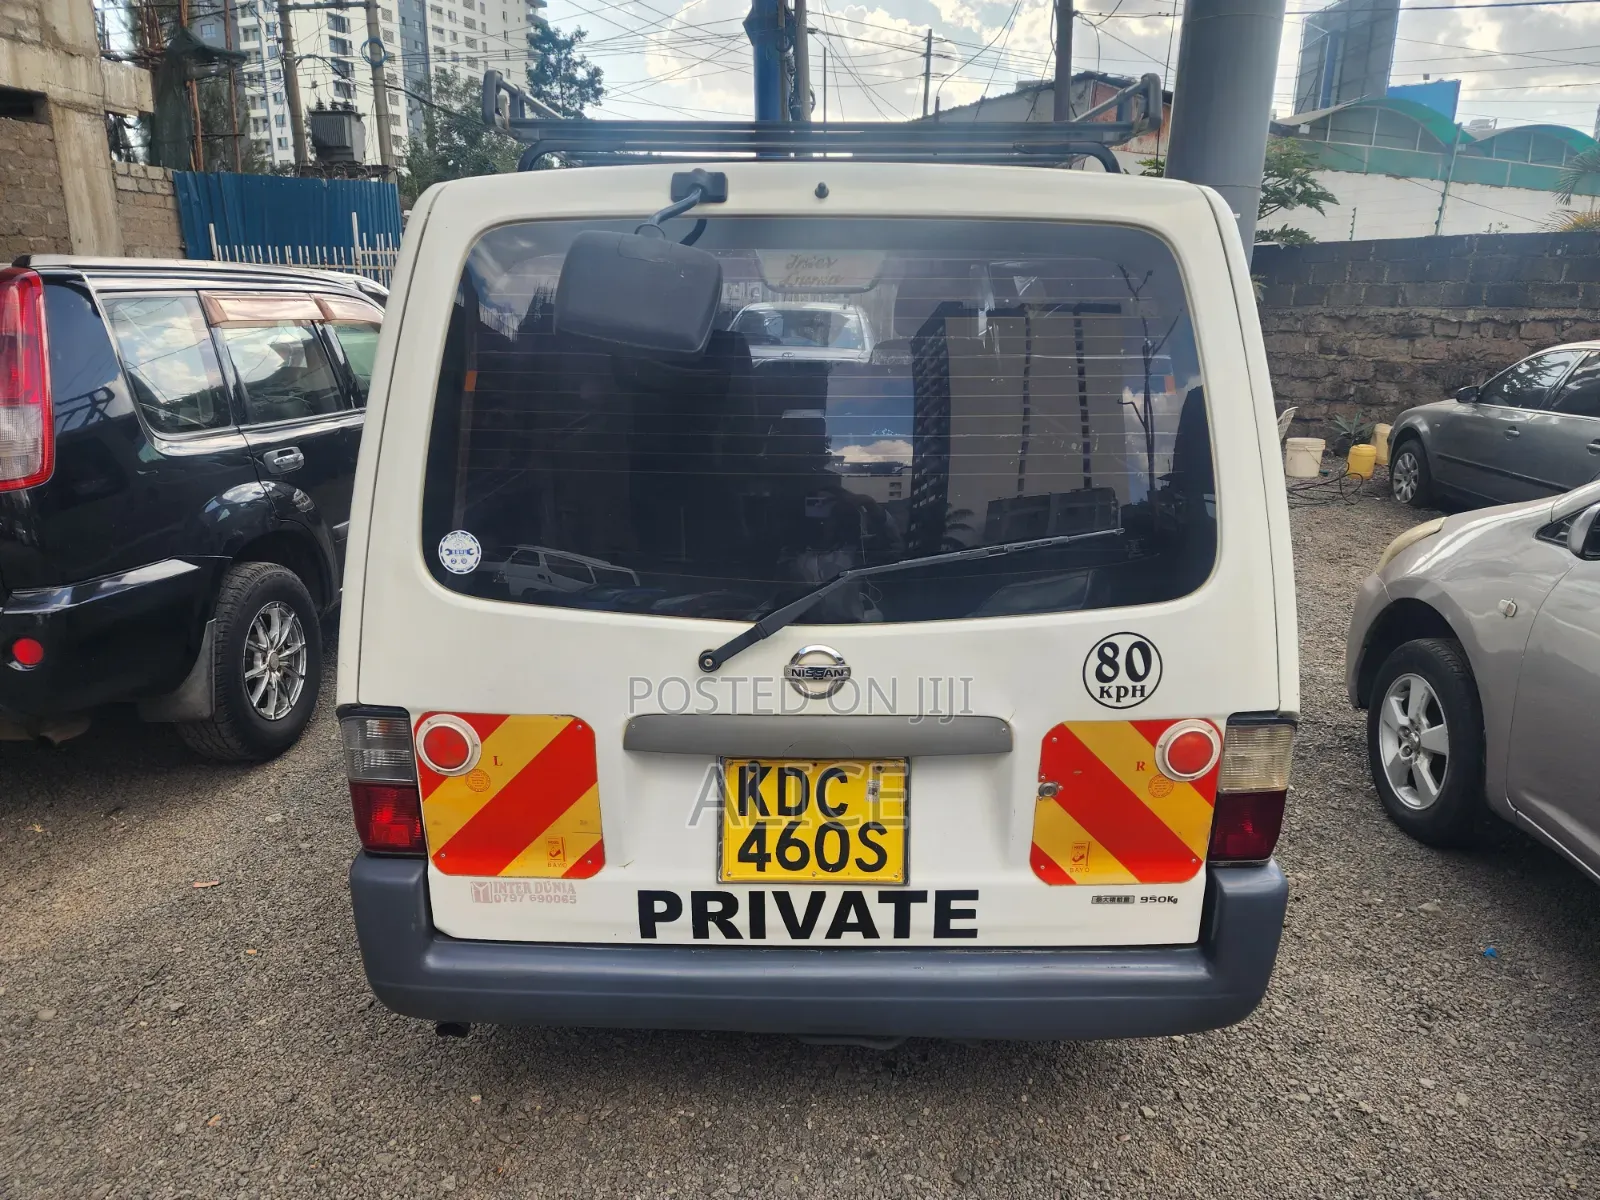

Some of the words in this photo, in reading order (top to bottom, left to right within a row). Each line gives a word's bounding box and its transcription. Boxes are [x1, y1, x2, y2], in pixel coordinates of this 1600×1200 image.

[791, 668, 844, 678] NISSAN
[1095, 640, 1152, 683] 80
[737, 765, 849, 817] KDC
[737, 821, 888, 873] 460S
[493, 881, 531, 894] INTER
[534, 881, 577, 895] DUNIA
[493, 894, 525, 903] 0797
[637, 889, 979, 940] PRIVATE
